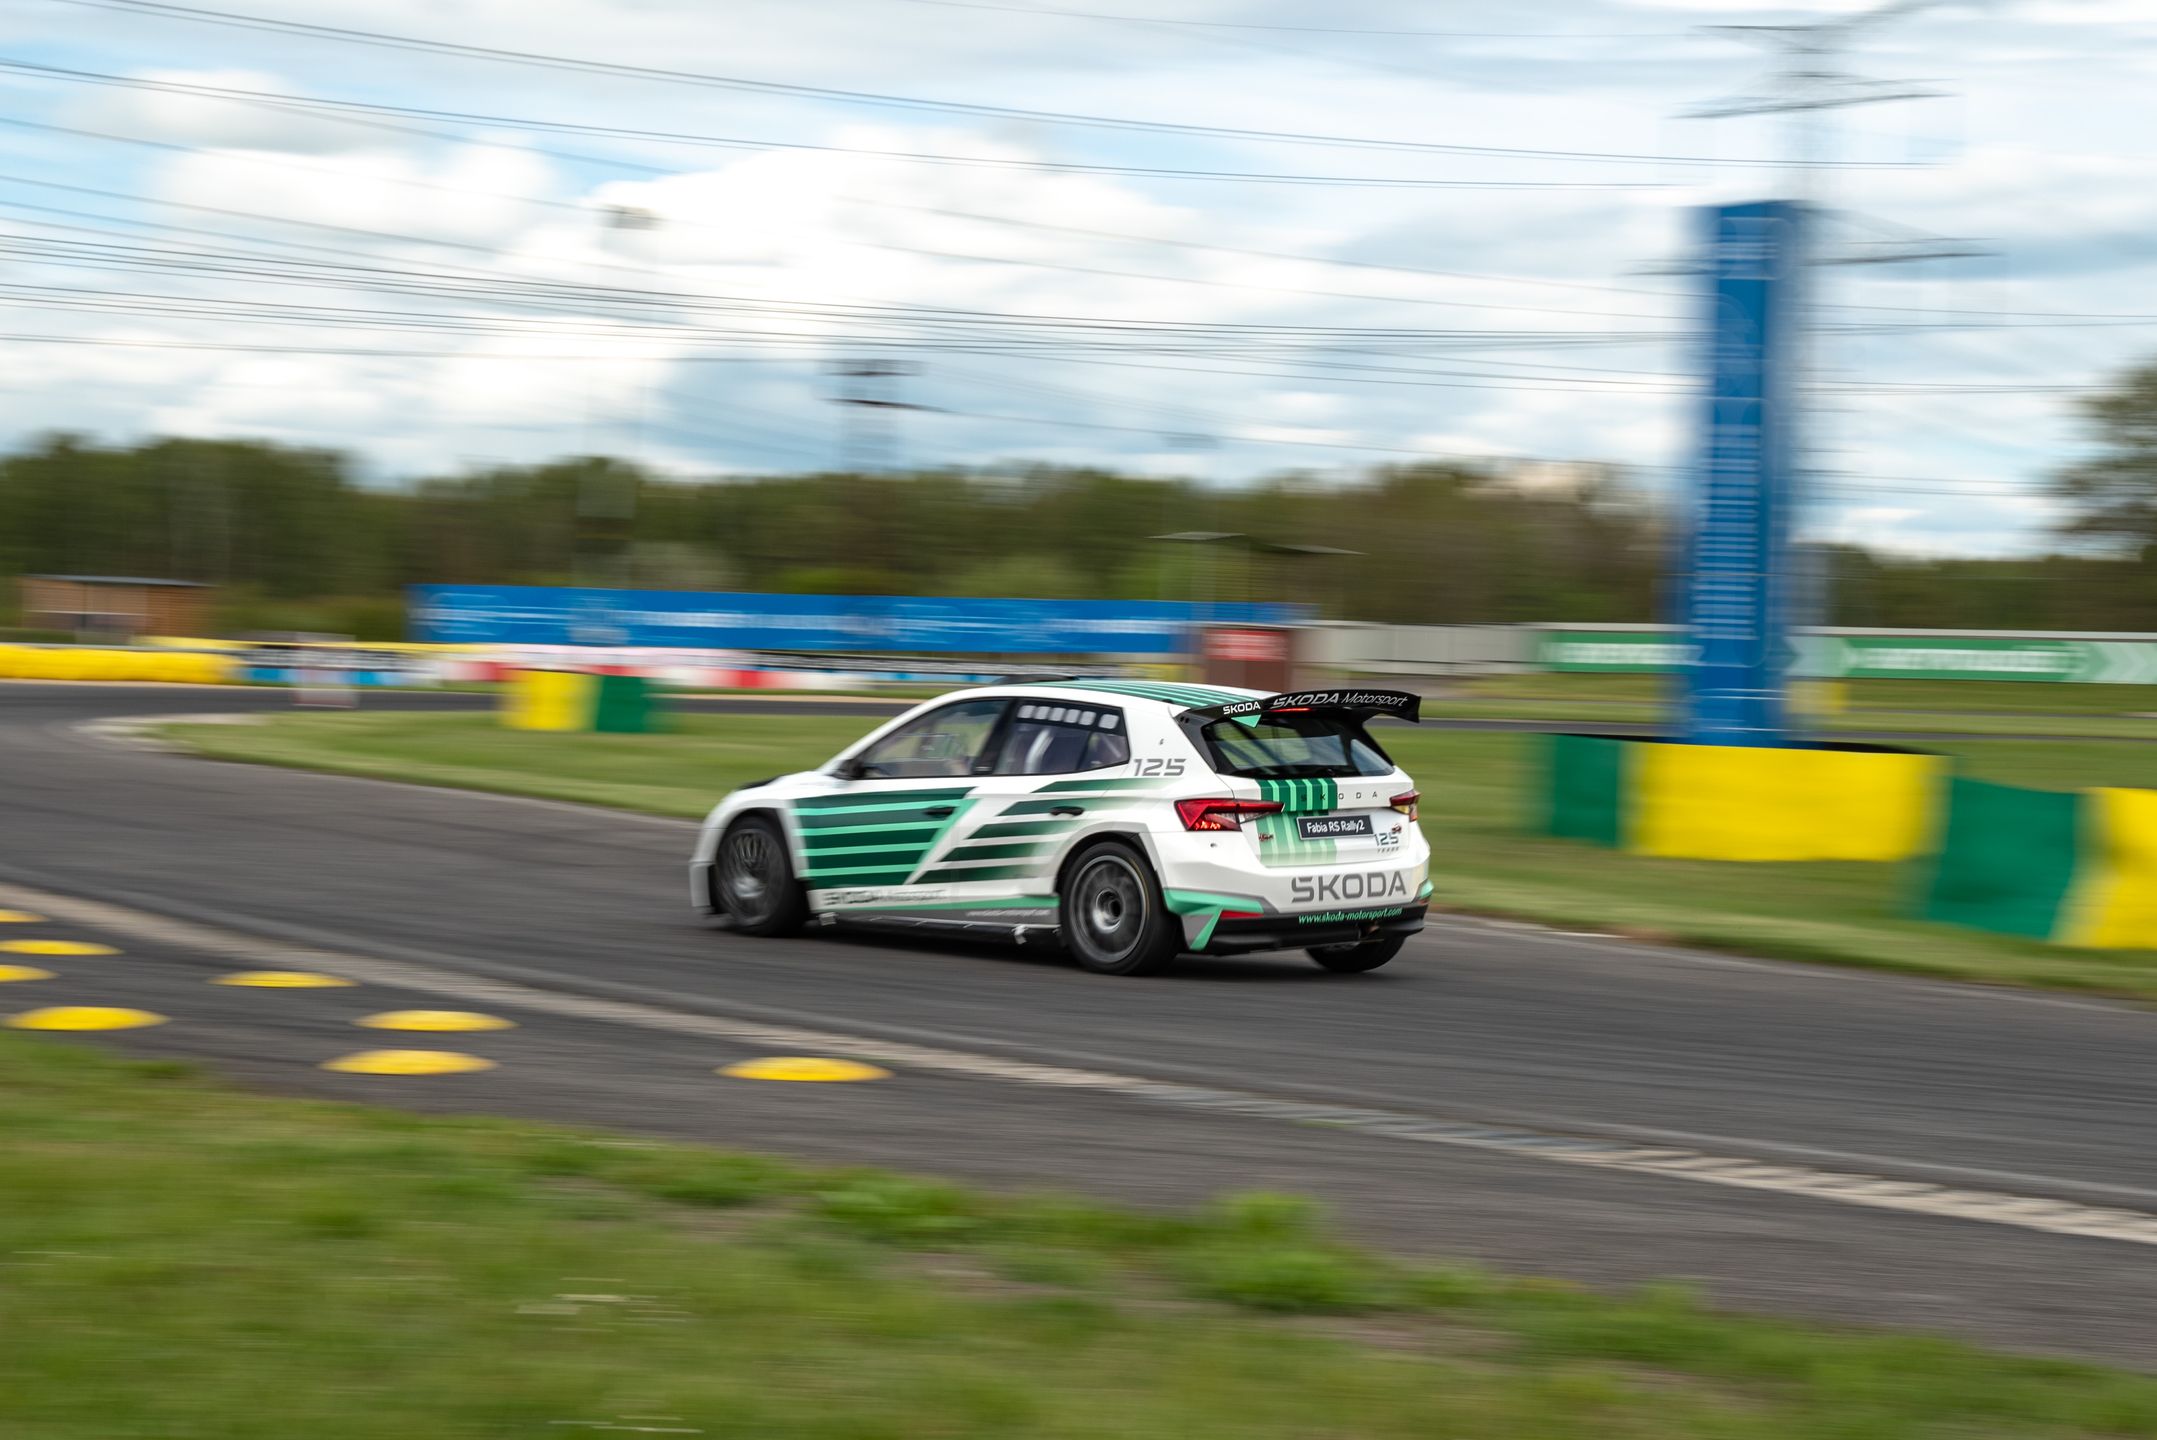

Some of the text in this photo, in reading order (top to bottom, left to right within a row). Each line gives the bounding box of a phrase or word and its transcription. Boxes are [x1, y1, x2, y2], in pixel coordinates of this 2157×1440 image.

[1341, 692, 1408, 707] Motorsport
[1134, 758, 1187, 777] 125
[1306, 819, 1365, 834] Fabia RS Rally2
[1375, 831, 1399, 846] 125
[1299, 908, 1402, 923] www.skoda-motorsport.com
